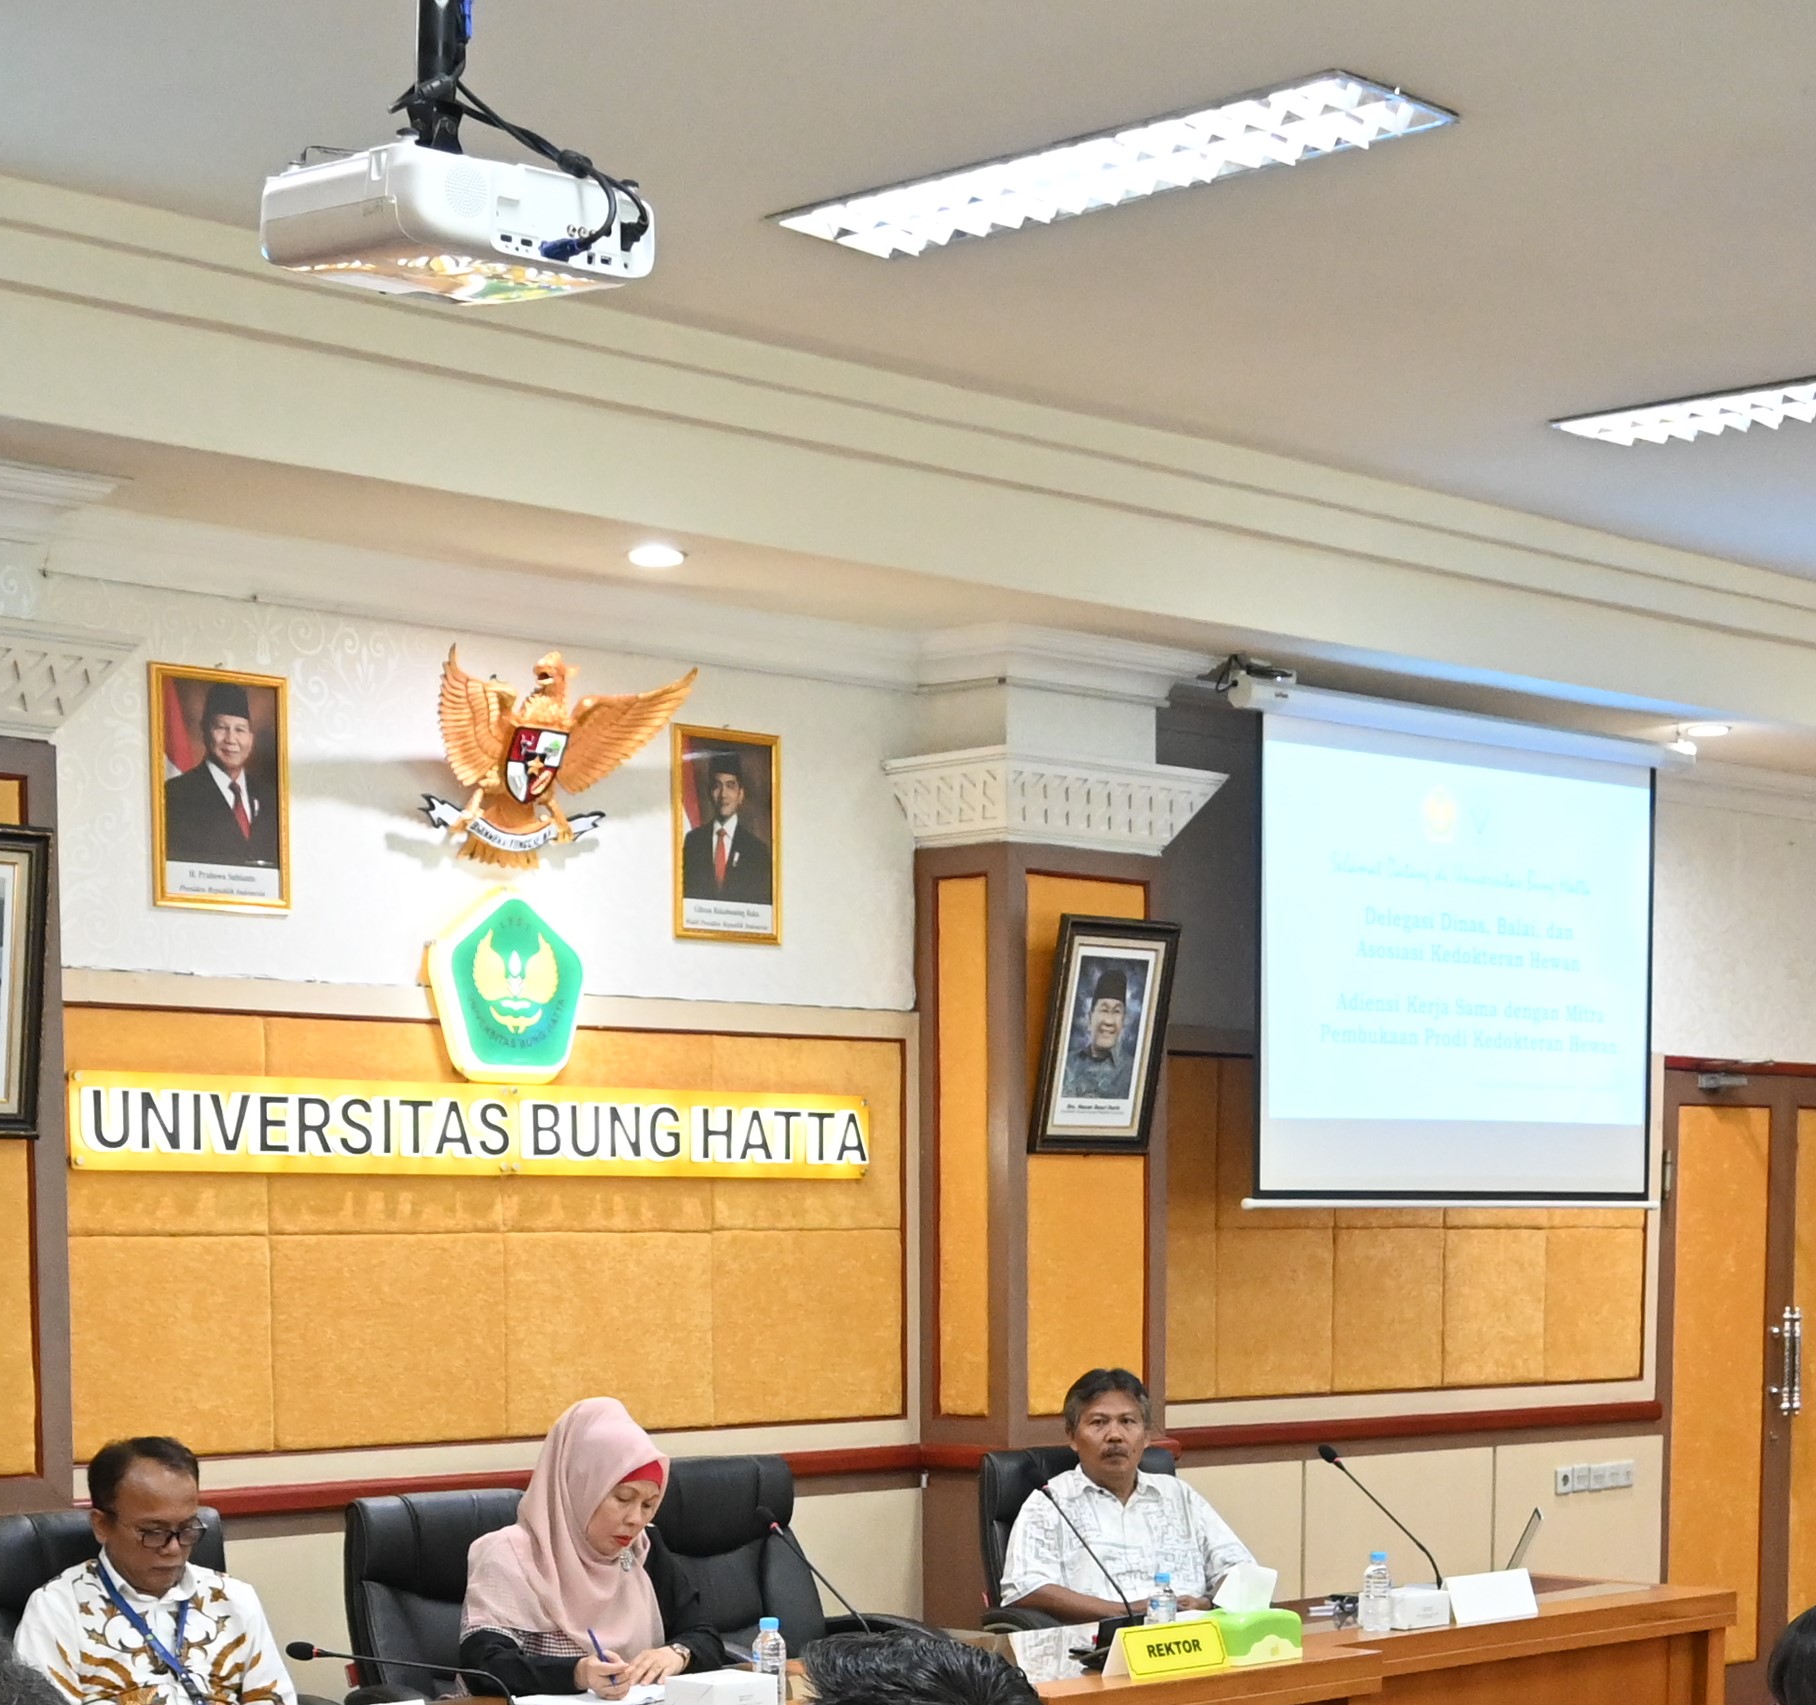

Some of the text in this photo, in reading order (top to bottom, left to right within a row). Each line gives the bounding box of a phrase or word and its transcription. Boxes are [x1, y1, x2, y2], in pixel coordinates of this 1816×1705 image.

[91, 1088, 869, 1165] UNIVERSITAS BUNG HATTA
[1146, 1638, 1203, 1659] REKTOR
